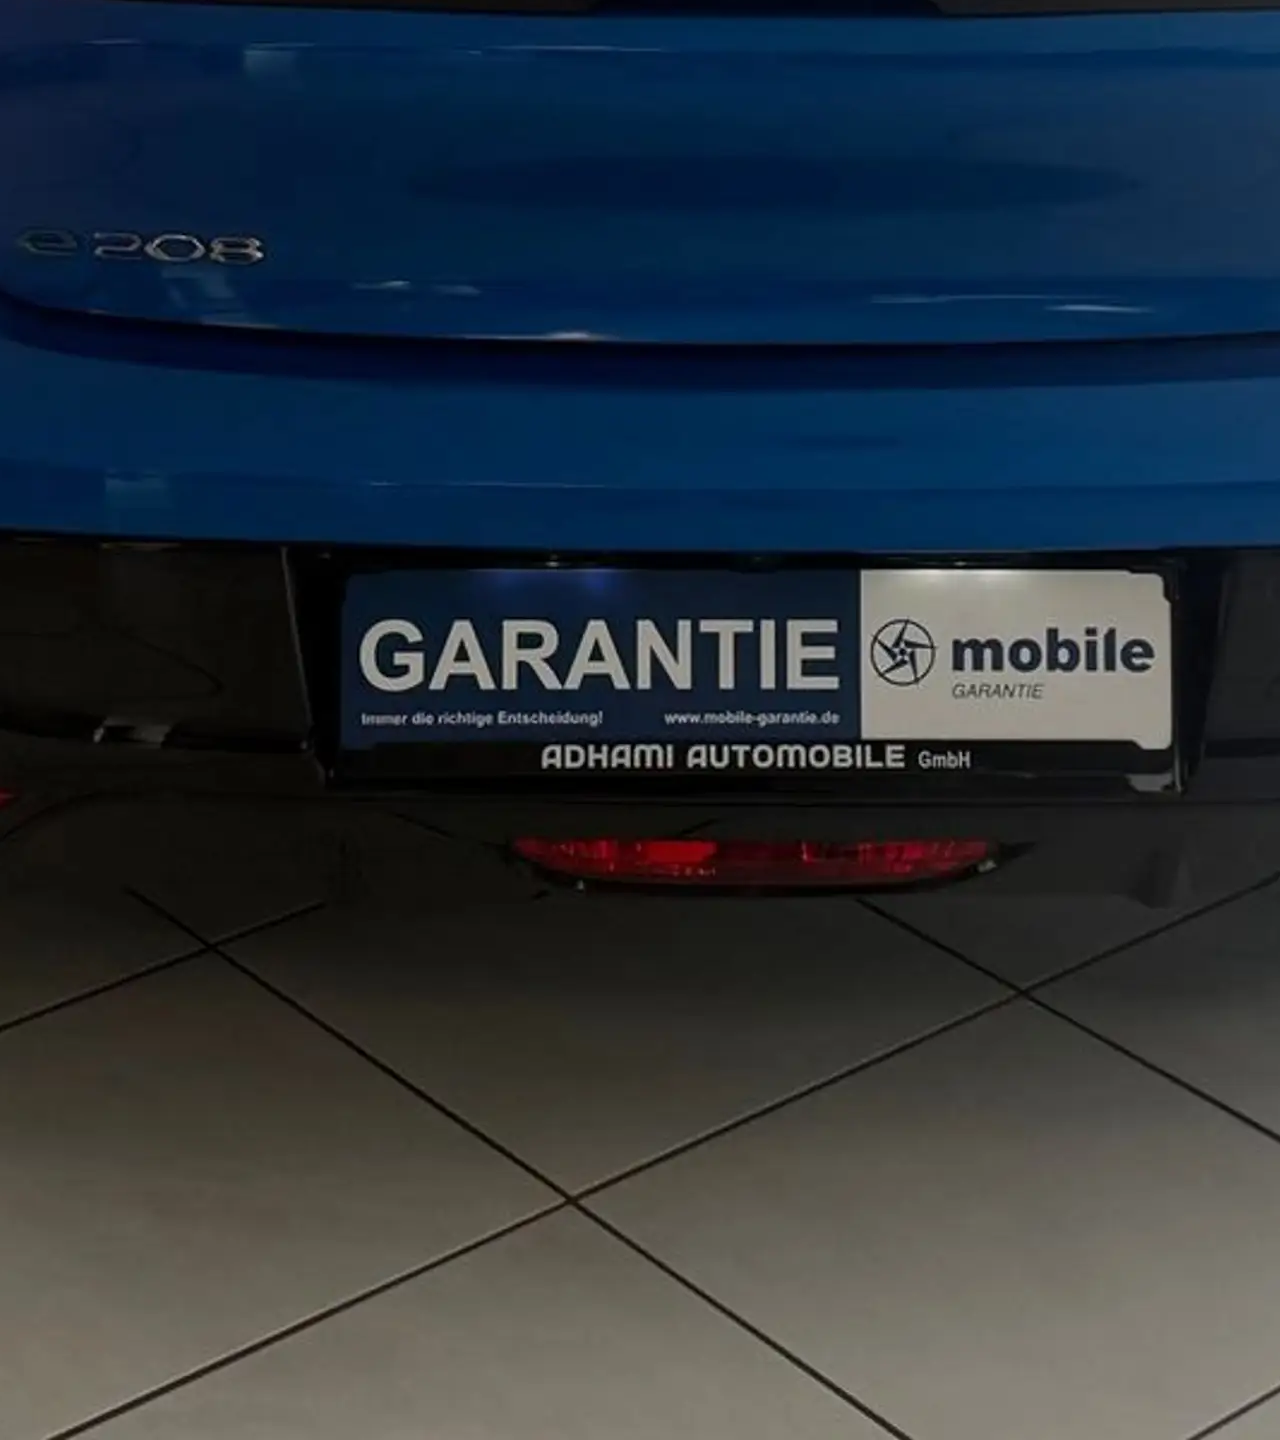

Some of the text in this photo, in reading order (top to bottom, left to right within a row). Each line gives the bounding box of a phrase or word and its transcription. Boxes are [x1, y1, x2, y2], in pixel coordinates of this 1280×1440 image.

[359, 617, 840, 692] GARANTIE
[951, 626, 1156, 673] mobile
[951, 682, 1046, 700] GARANTIE
[361, 710, 604, 728] Immer die richtige Entscheidung!
[664, 710, 840, 728] www.mobile-garantie.de
[540, 743, 972, 770] ADHAMI AUTOMOBILE GmbH
